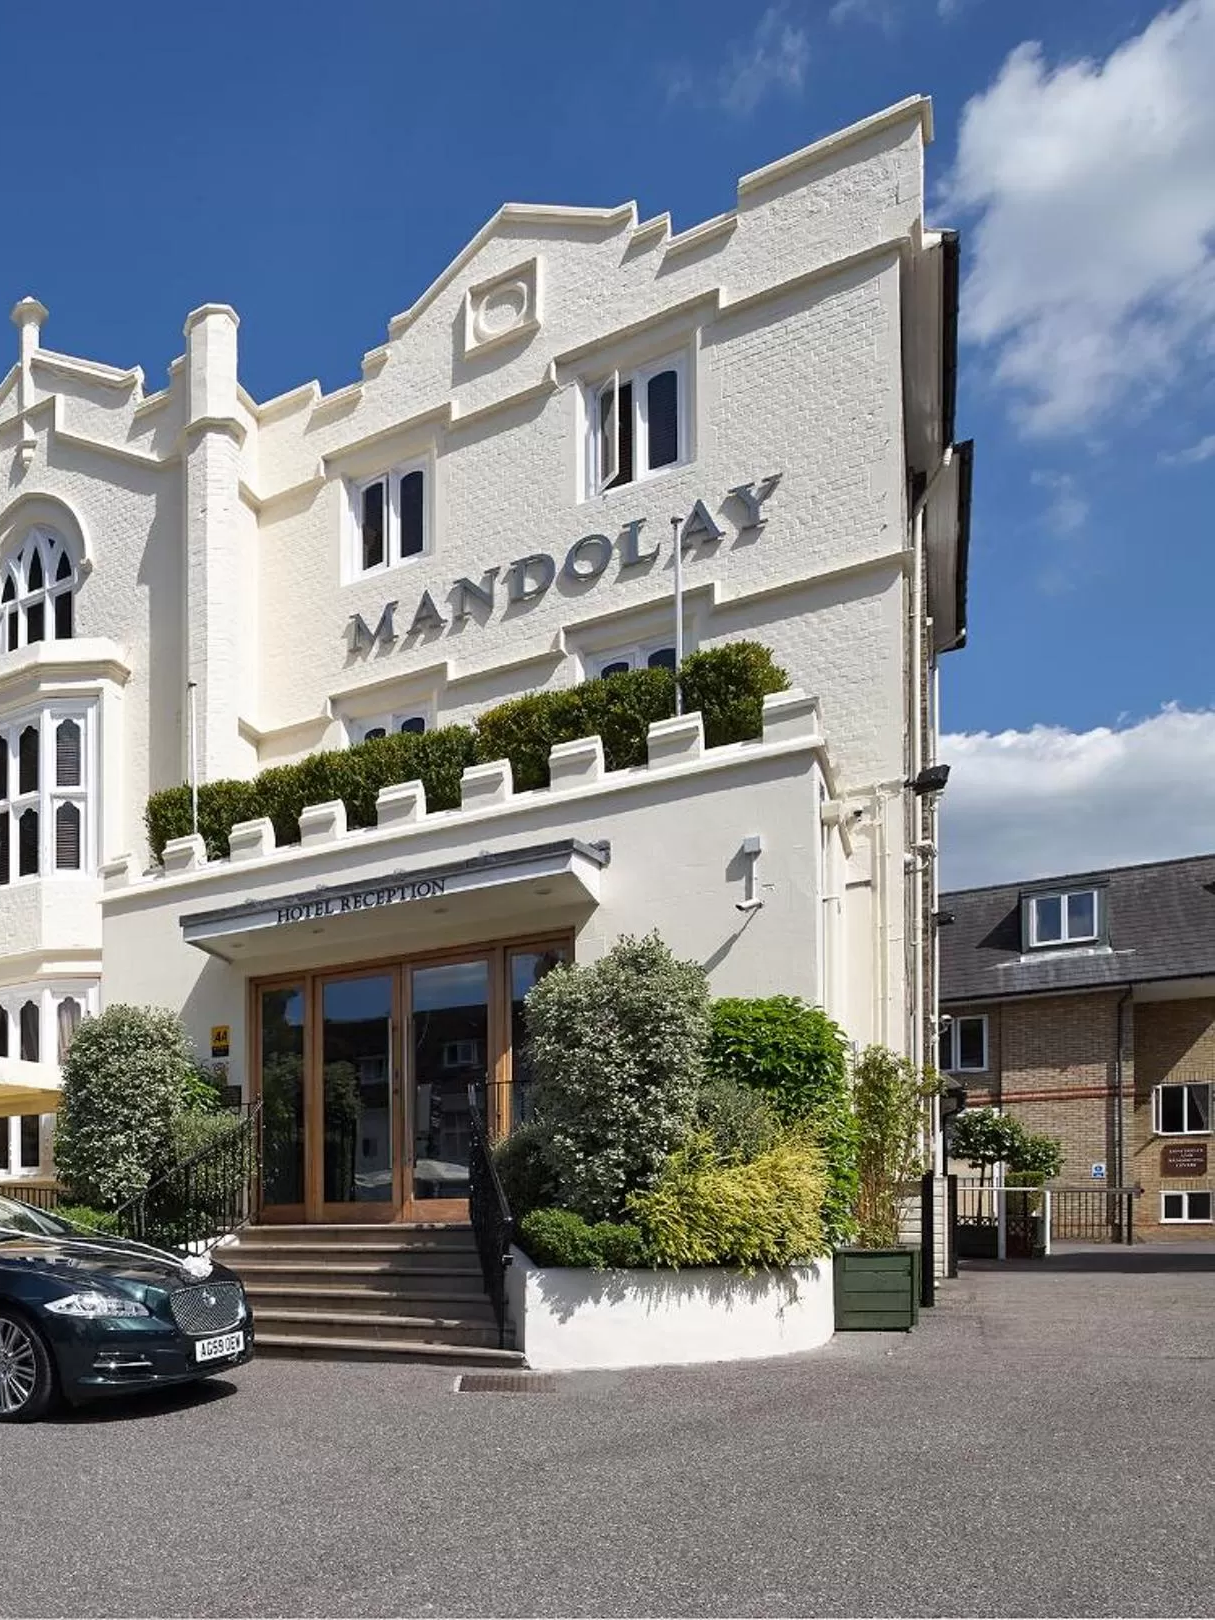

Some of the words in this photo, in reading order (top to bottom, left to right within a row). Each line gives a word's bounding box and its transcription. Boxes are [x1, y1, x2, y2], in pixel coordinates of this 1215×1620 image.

[349, 472, 783, 653] MANDOLAY
[277, 902, 335, 923] HOTEL
[340, 879, 446, 912] RECEPTION
